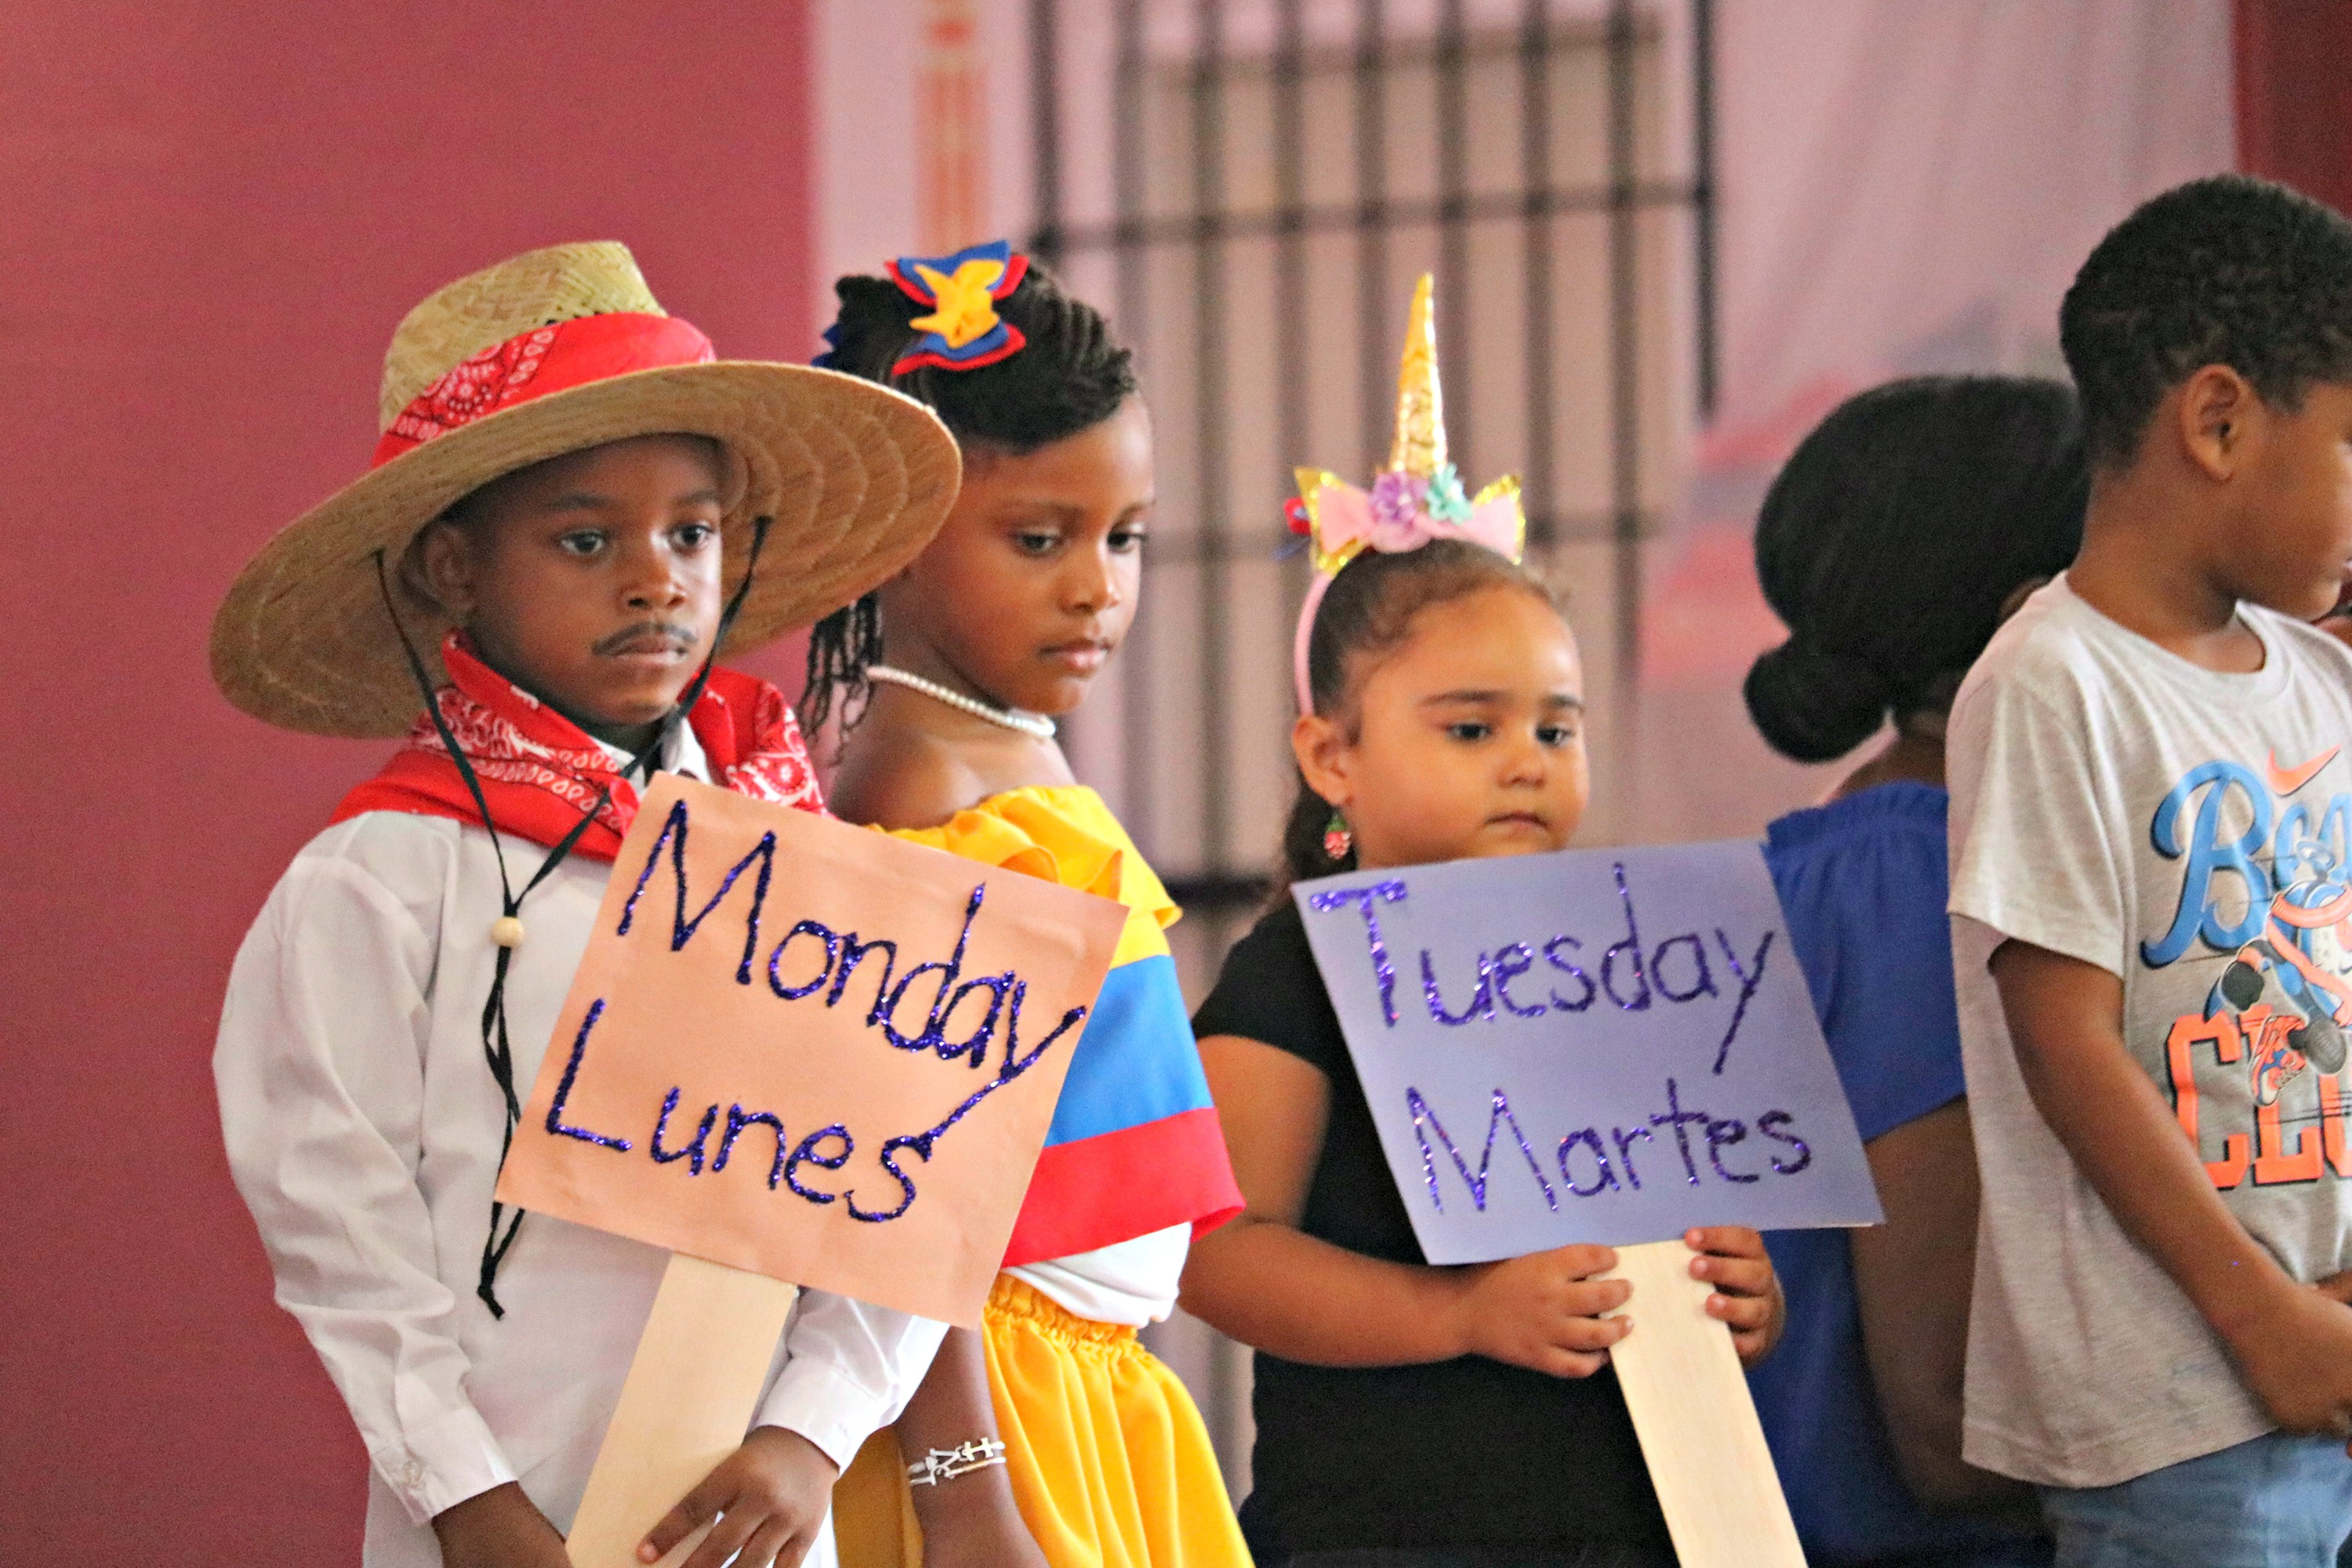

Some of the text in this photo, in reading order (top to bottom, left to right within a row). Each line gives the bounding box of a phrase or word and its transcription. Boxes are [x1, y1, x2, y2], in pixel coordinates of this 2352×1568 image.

[617, 798, 1086, 1145] Monday
[1310, 862, 1777, 1075] Tuesday
[545, 998, 935, 1223] Lunes
[1406, 1077, 1813, 1214] Martes
